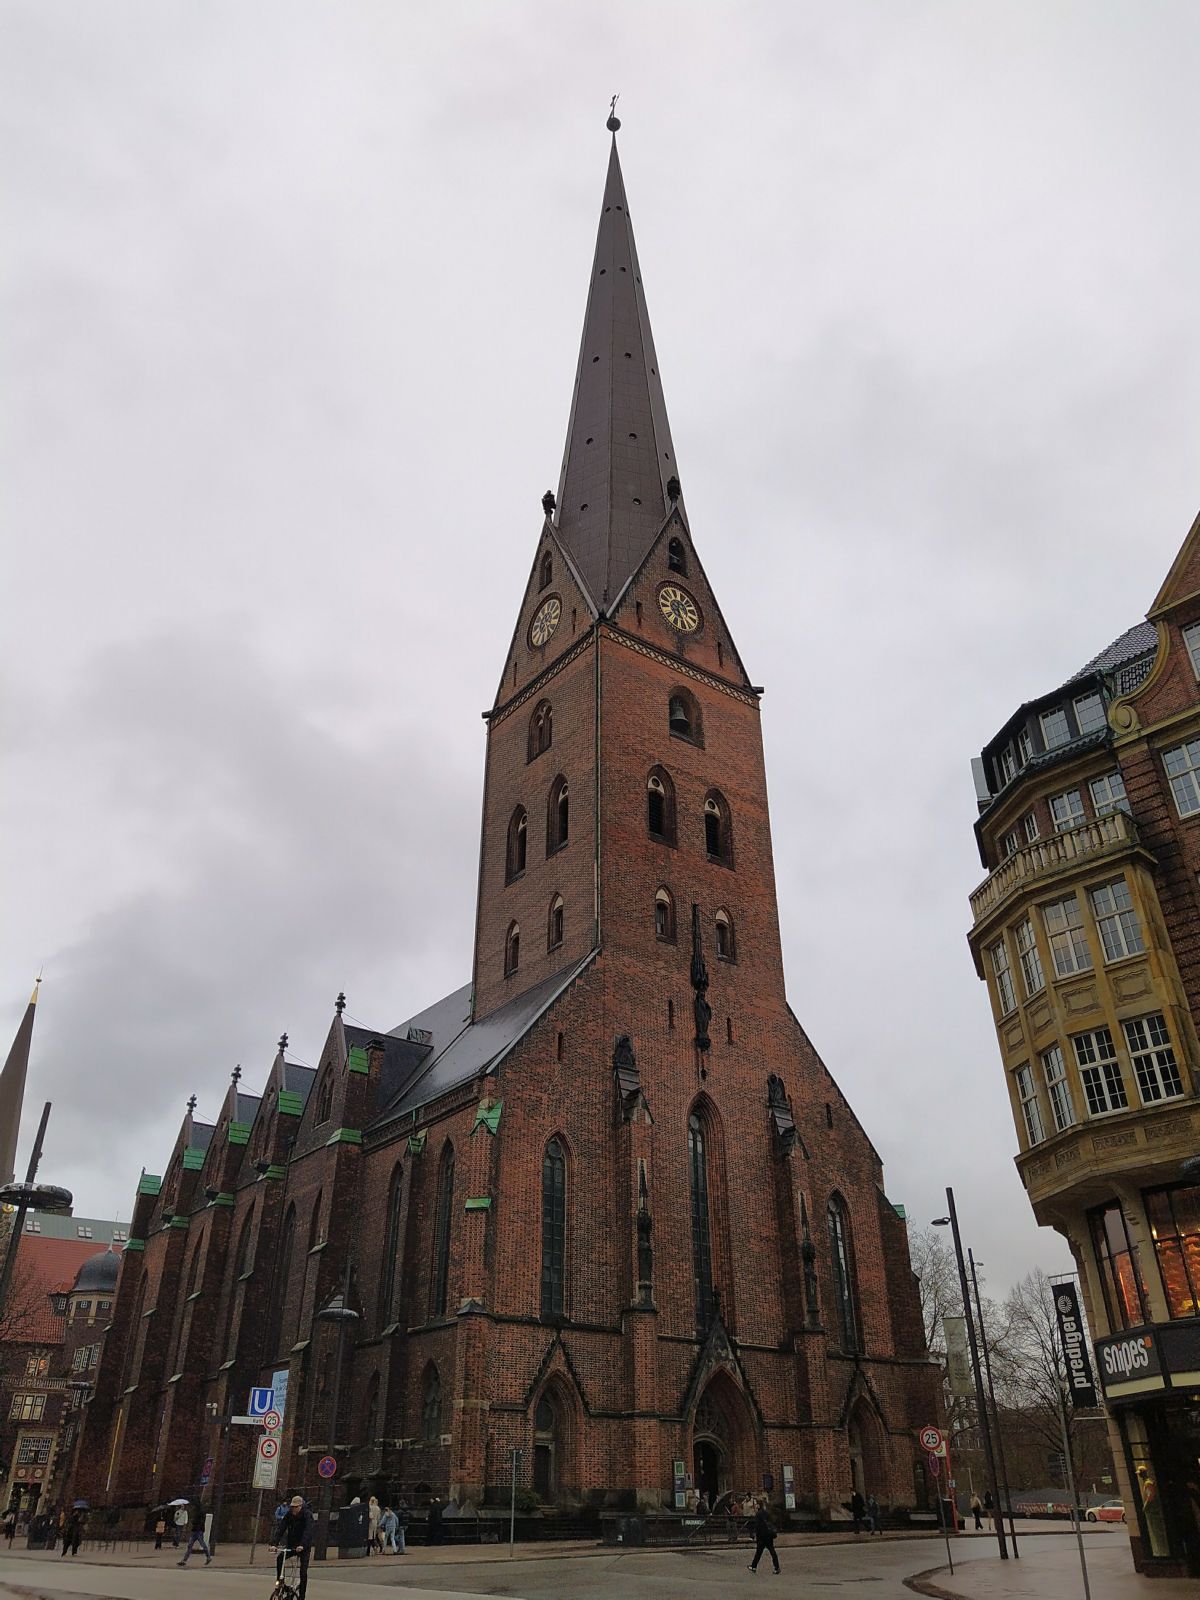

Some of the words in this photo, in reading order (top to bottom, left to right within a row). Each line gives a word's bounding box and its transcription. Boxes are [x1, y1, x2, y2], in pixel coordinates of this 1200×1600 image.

[1062, 1315, 1091, 1389] prediger
[1103, 1338, 1149, 1377] snipes
[255, 1391, 271, 1413] U
[267, 1416, 277, 1426] 25
[925, 1433, 938, 1445] 25
